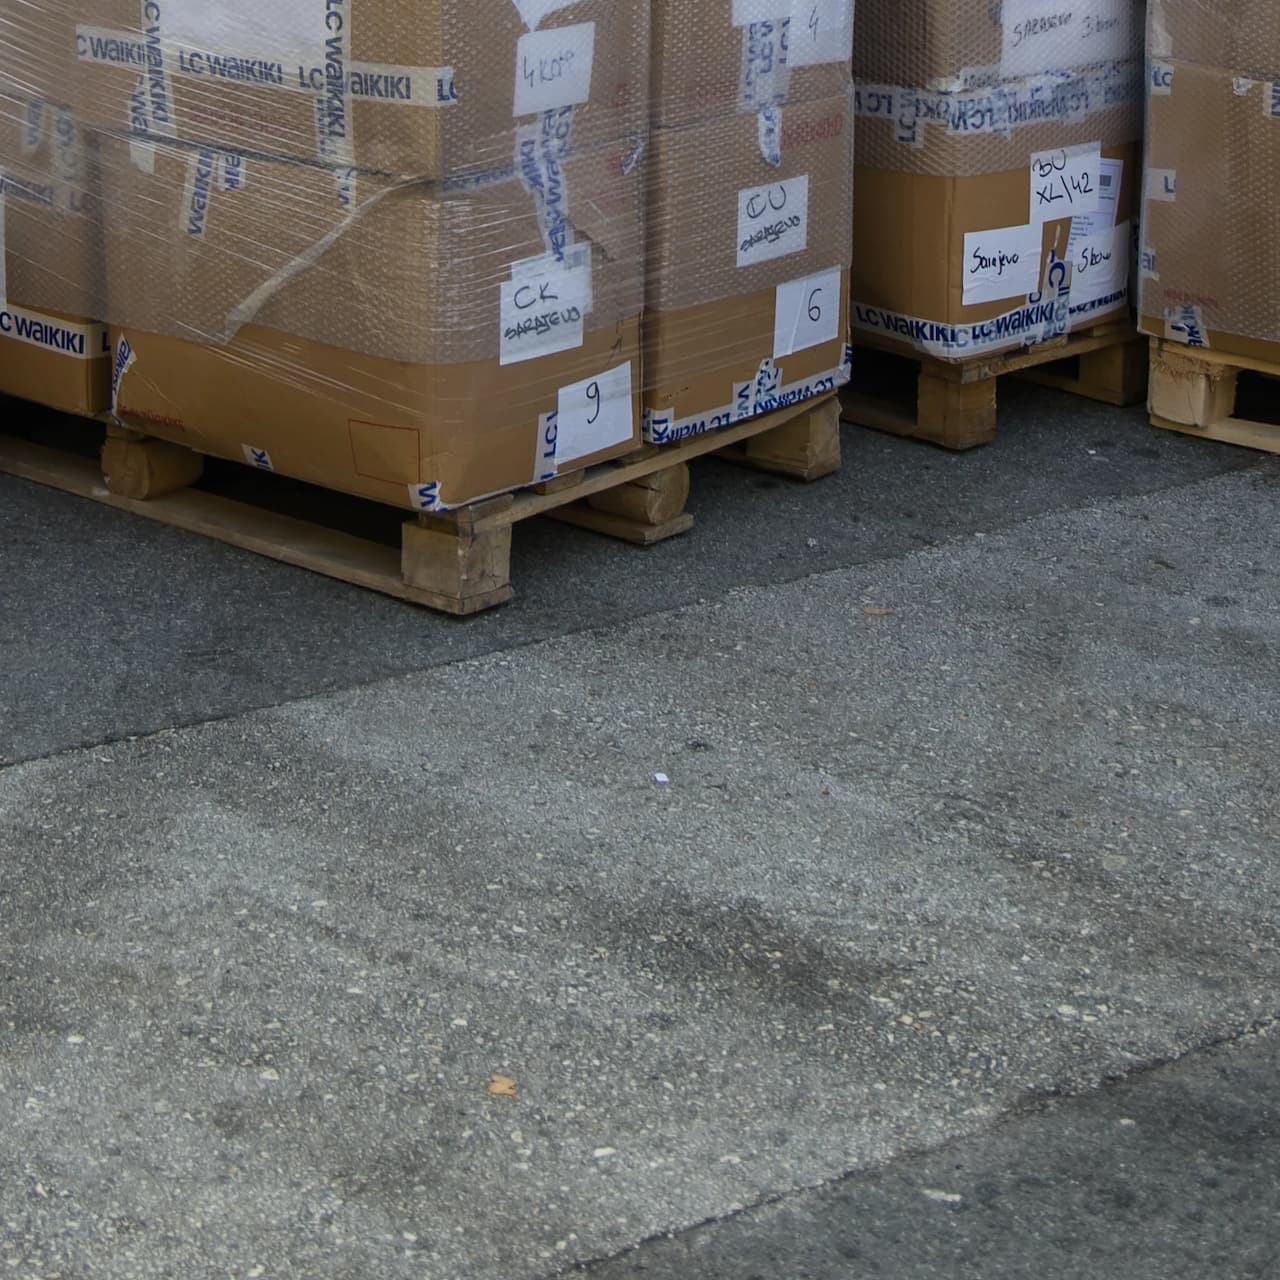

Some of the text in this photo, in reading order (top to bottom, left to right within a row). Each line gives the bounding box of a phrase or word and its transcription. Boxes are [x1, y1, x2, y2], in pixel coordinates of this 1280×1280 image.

[179, 49, 204, 73] LC
[298, 65, 324, 89] LC
[807, 288, 822, 322] 6
[855, 305, 879, 326] LC
[585, 381, 600, 425] 9
